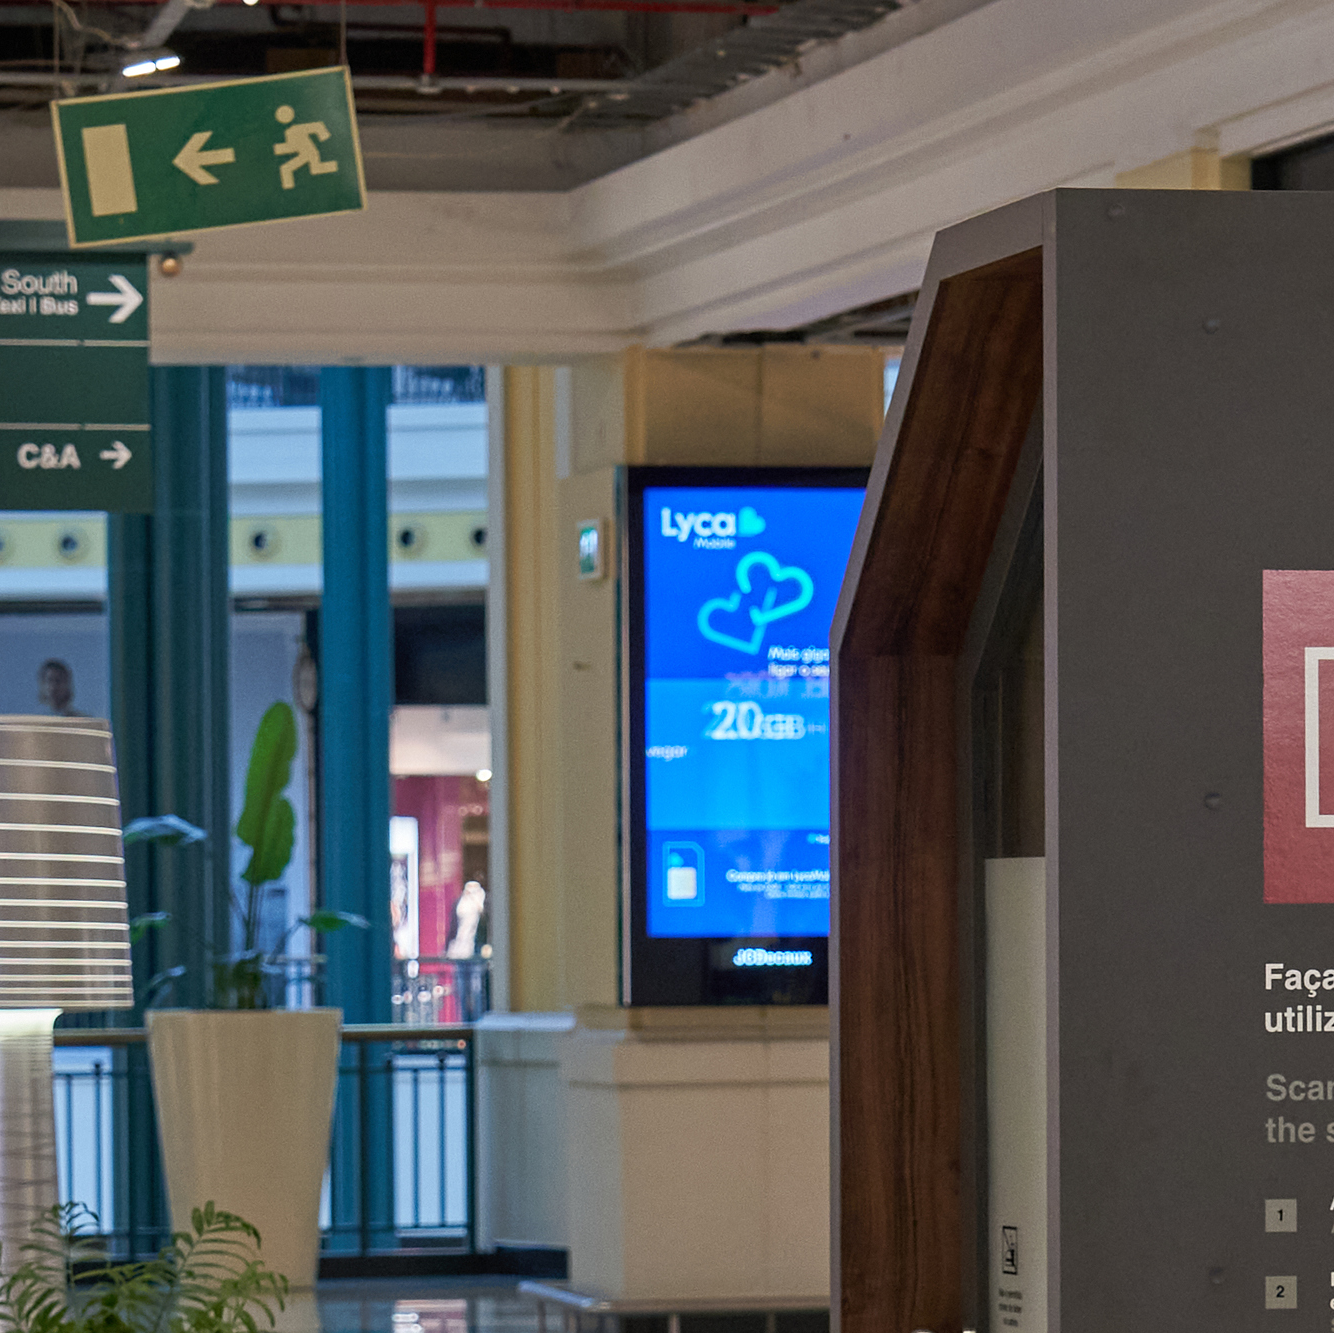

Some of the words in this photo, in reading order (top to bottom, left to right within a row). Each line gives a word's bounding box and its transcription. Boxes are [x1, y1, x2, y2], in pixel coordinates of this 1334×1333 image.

[1, 269, 78, 294] South
[40, 296, 78, 315] Bus
[17, 442, 81, 469] C&A
[661, 506, 736, 542] Lyca
[1265, 1116, 1315, 1143] the
[1277, 1209, 1284, 1221] 1
[1275, 1286, 1285, 1298] 2
